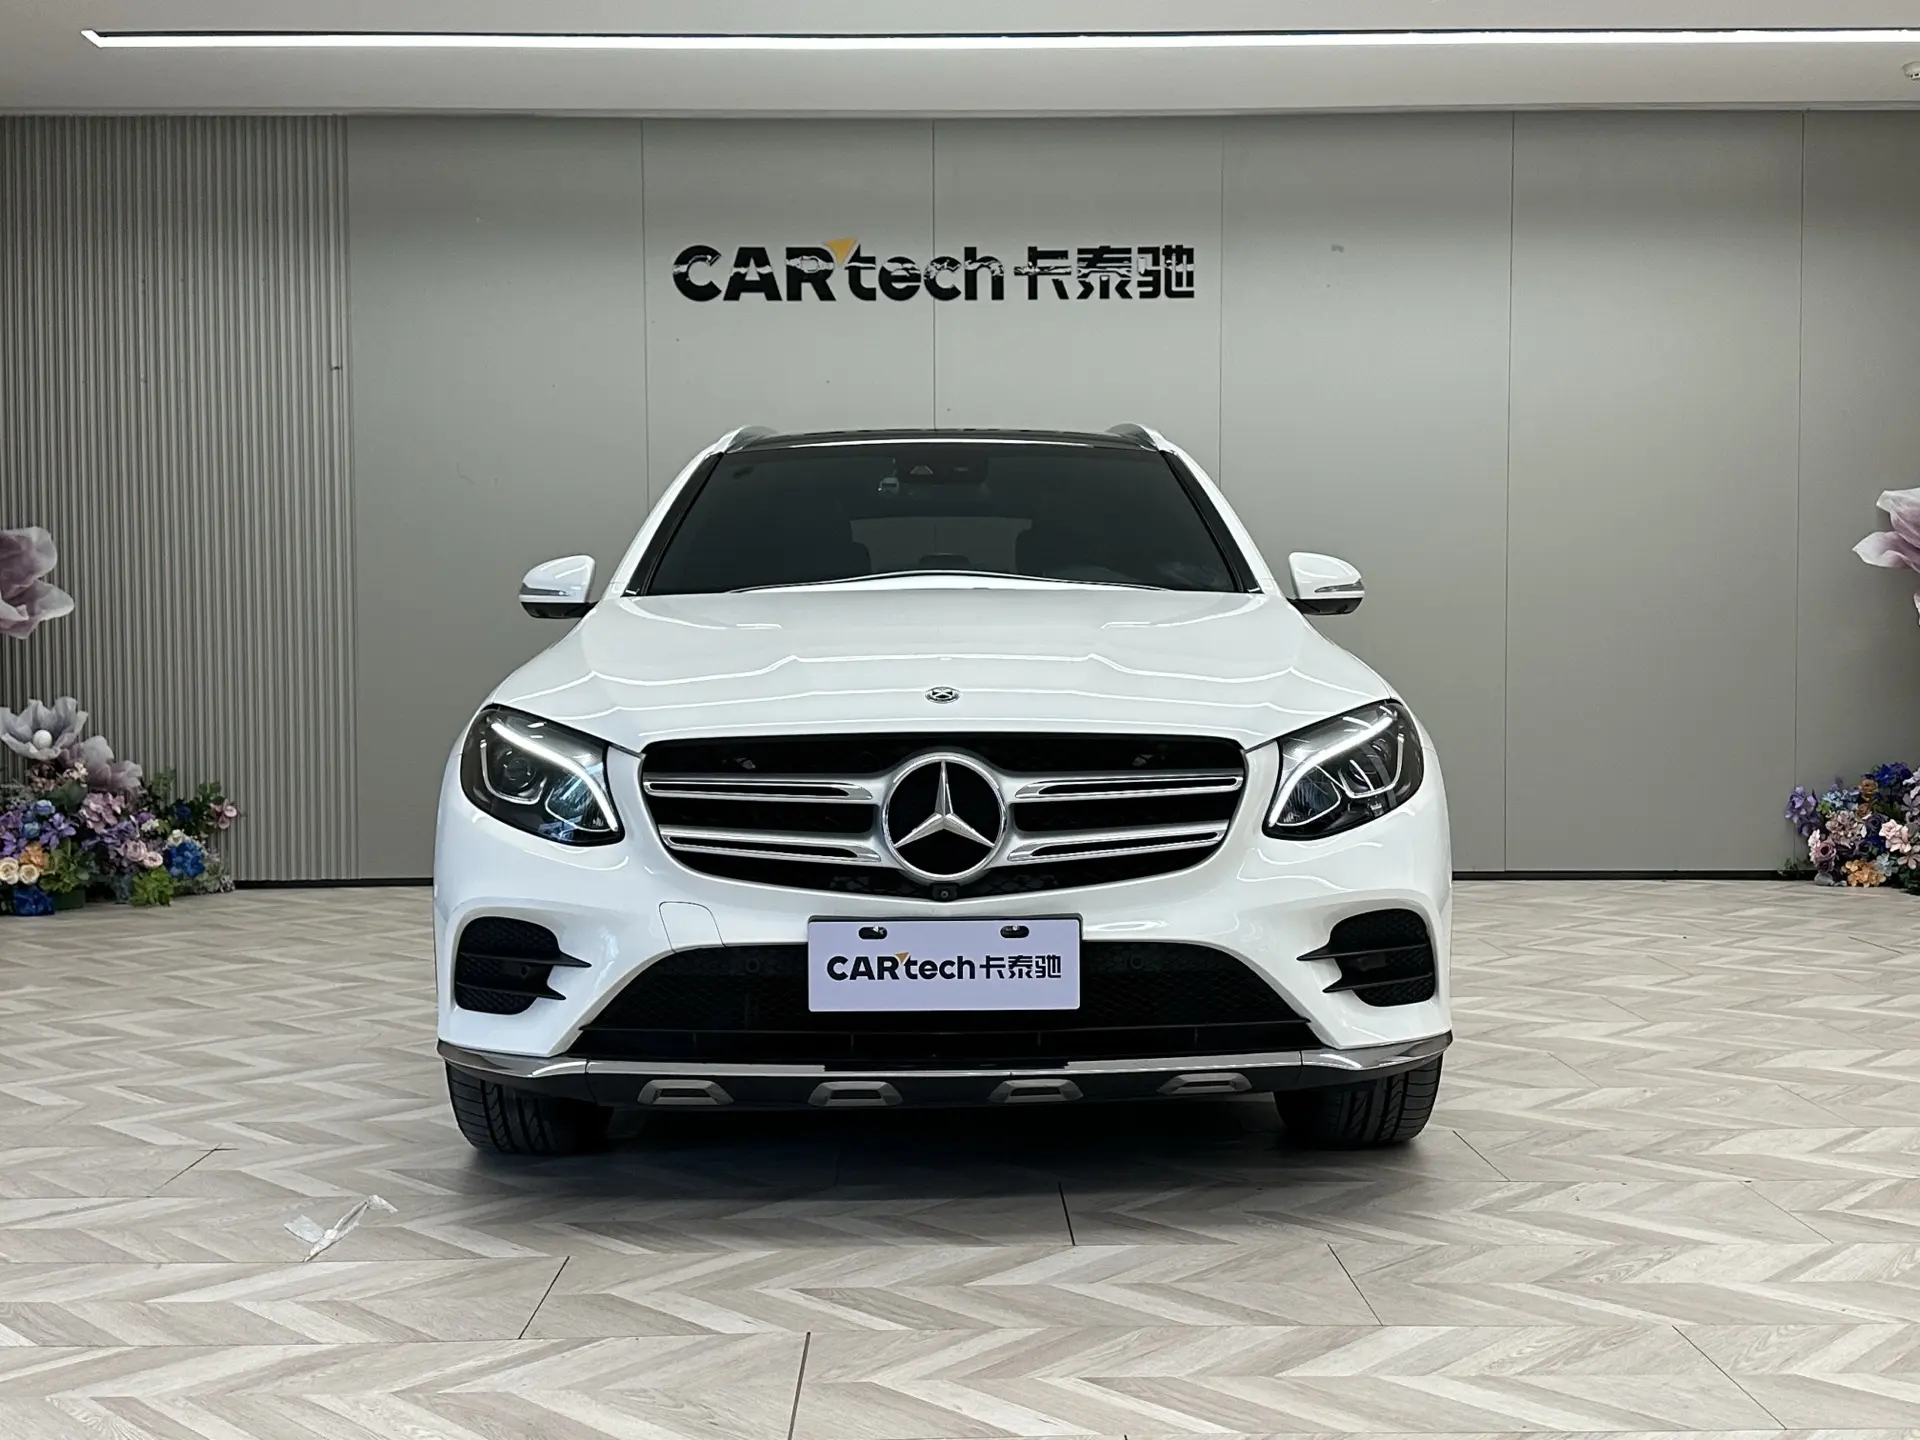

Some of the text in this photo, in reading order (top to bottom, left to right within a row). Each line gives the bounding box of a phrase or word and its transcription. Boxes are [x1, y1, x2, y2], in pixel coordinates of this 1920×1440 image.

[1012, 243, 1196, 301] 卡泰驰
[979, 954, 1062, 980] 卡泰驰
